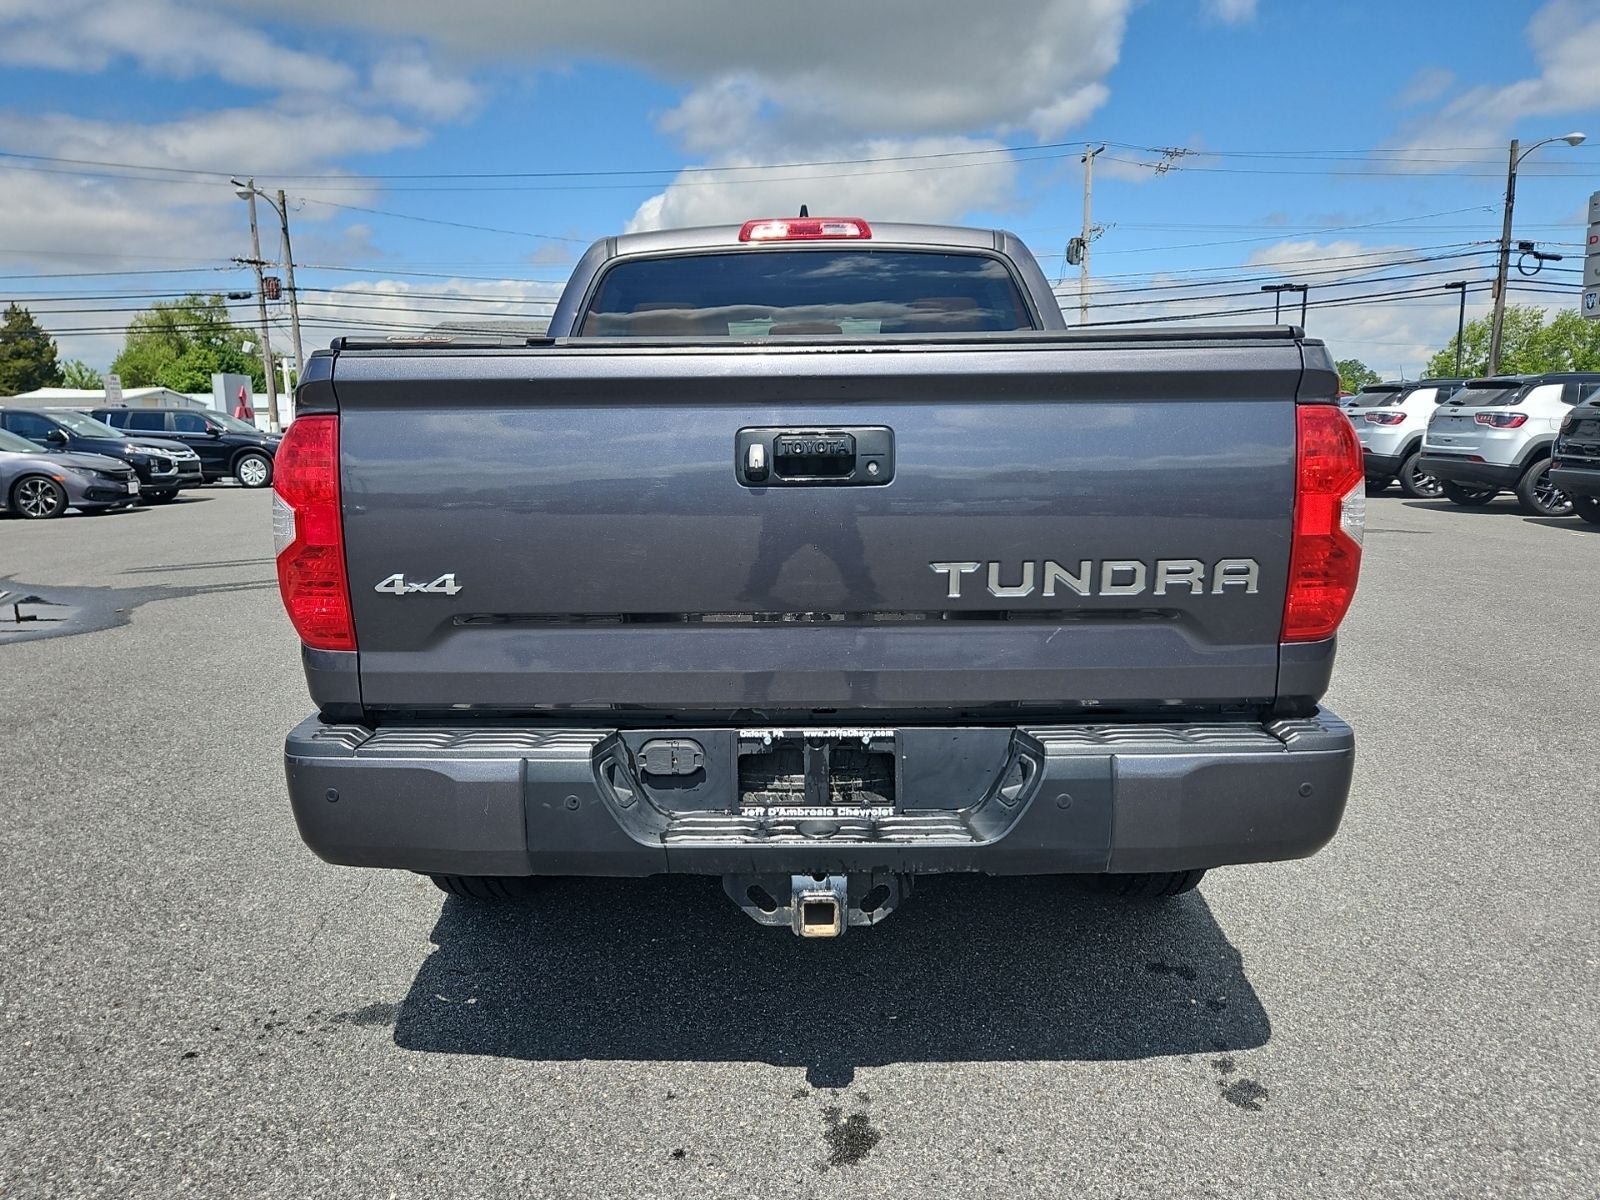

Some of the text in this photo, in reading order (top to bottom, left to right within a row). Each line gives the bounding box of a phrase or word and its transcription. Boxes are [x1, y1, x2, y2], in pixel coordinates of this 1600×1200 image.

[781, 440, 849, 455] TOYOTA
[374, 573, 463, 595] 4x4
[929, 558, 1259, 598] TUNDRA
[772, 729, 784, 738] PA
[741, 807, 894, 817] Jeff D'Ambrosio Chevrolet
